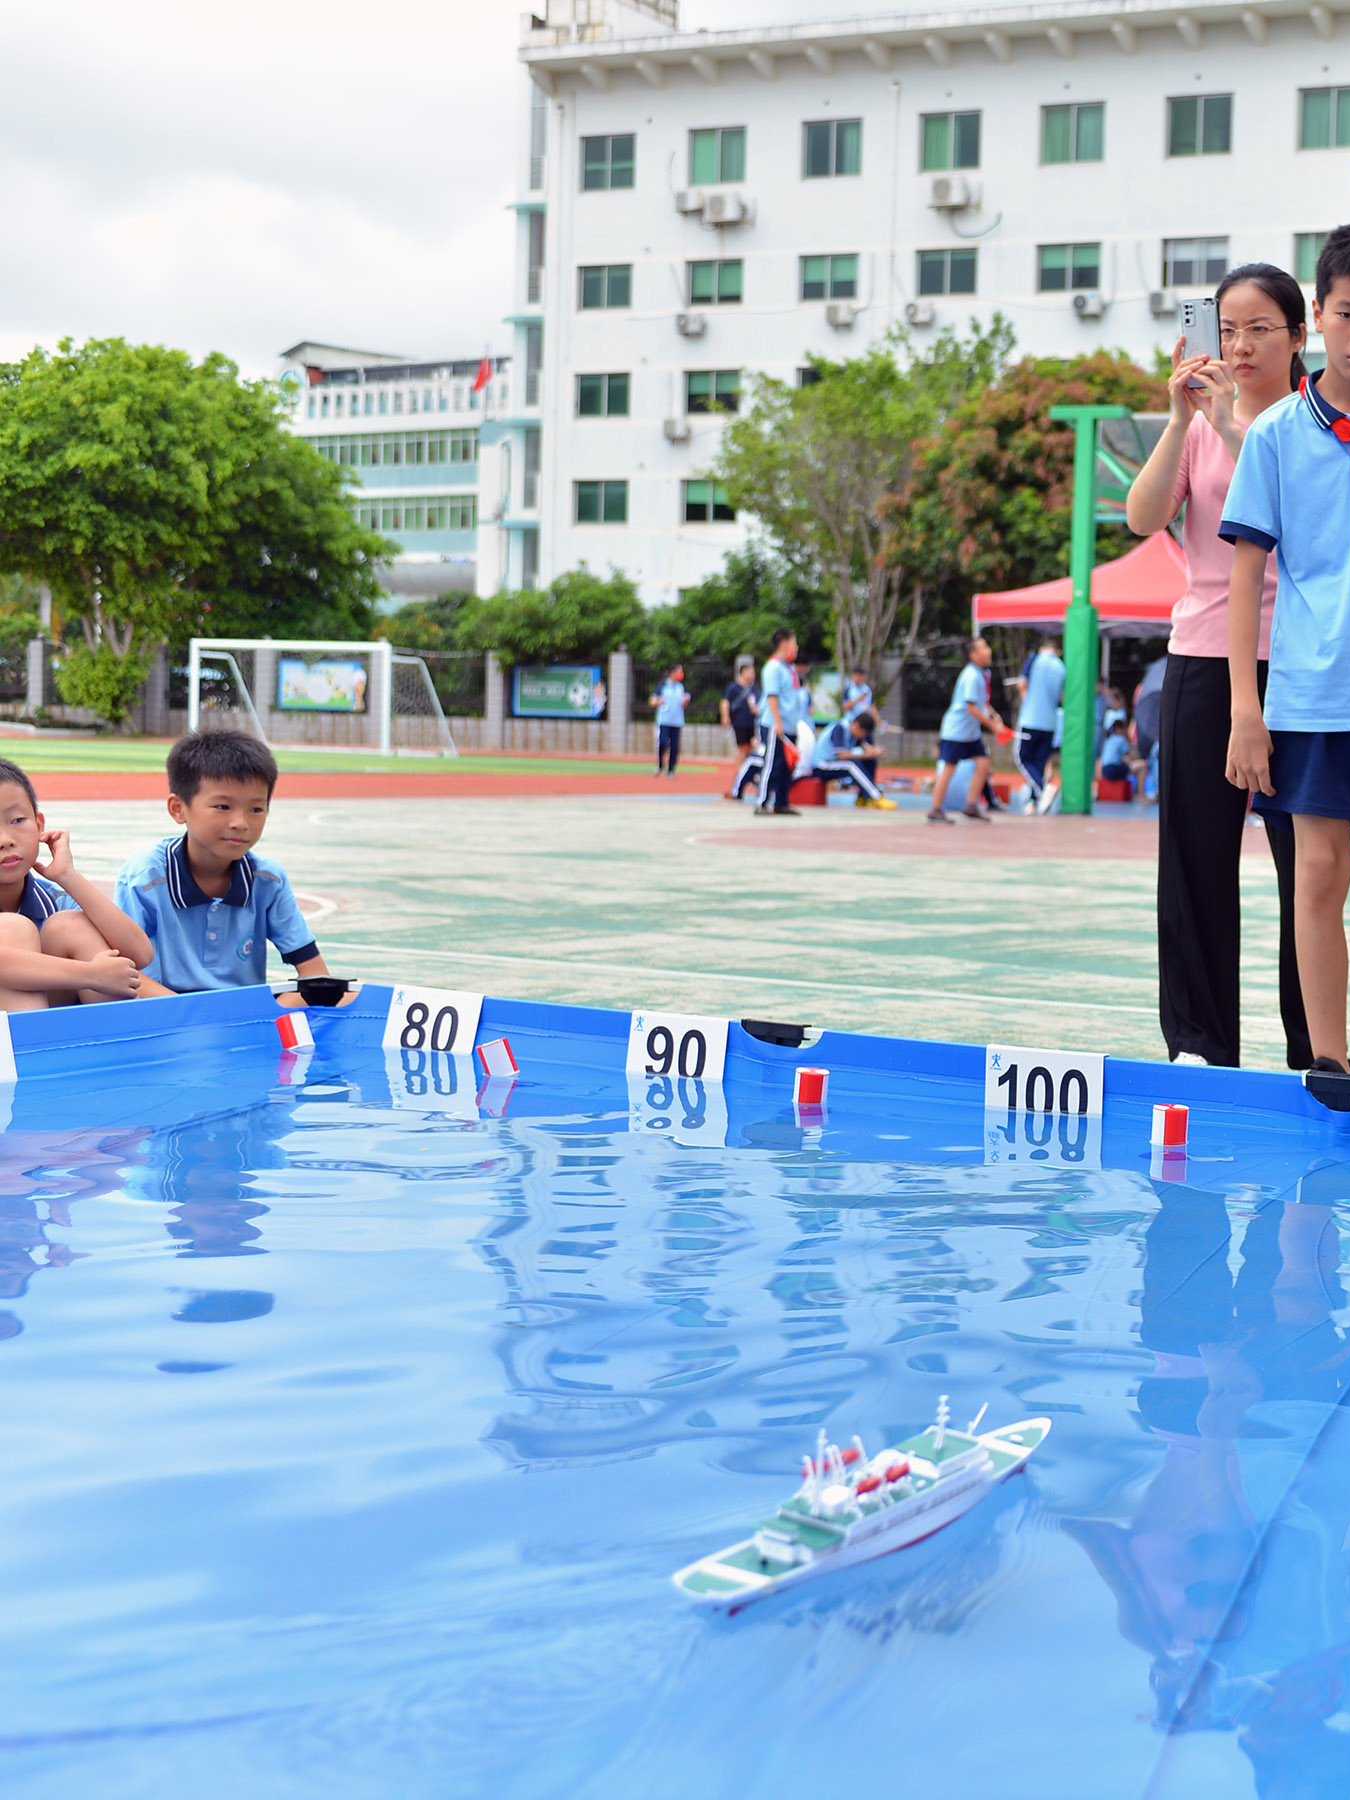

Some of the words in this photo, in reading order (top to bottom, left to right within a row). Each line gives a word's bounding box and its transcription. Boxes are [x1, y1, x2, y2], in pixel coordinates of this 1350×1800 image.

[400, 1002, 459, 1051] 80
[645, 1026, 707, 1078] 90
[998, 1063, 1089, 1115] 100
